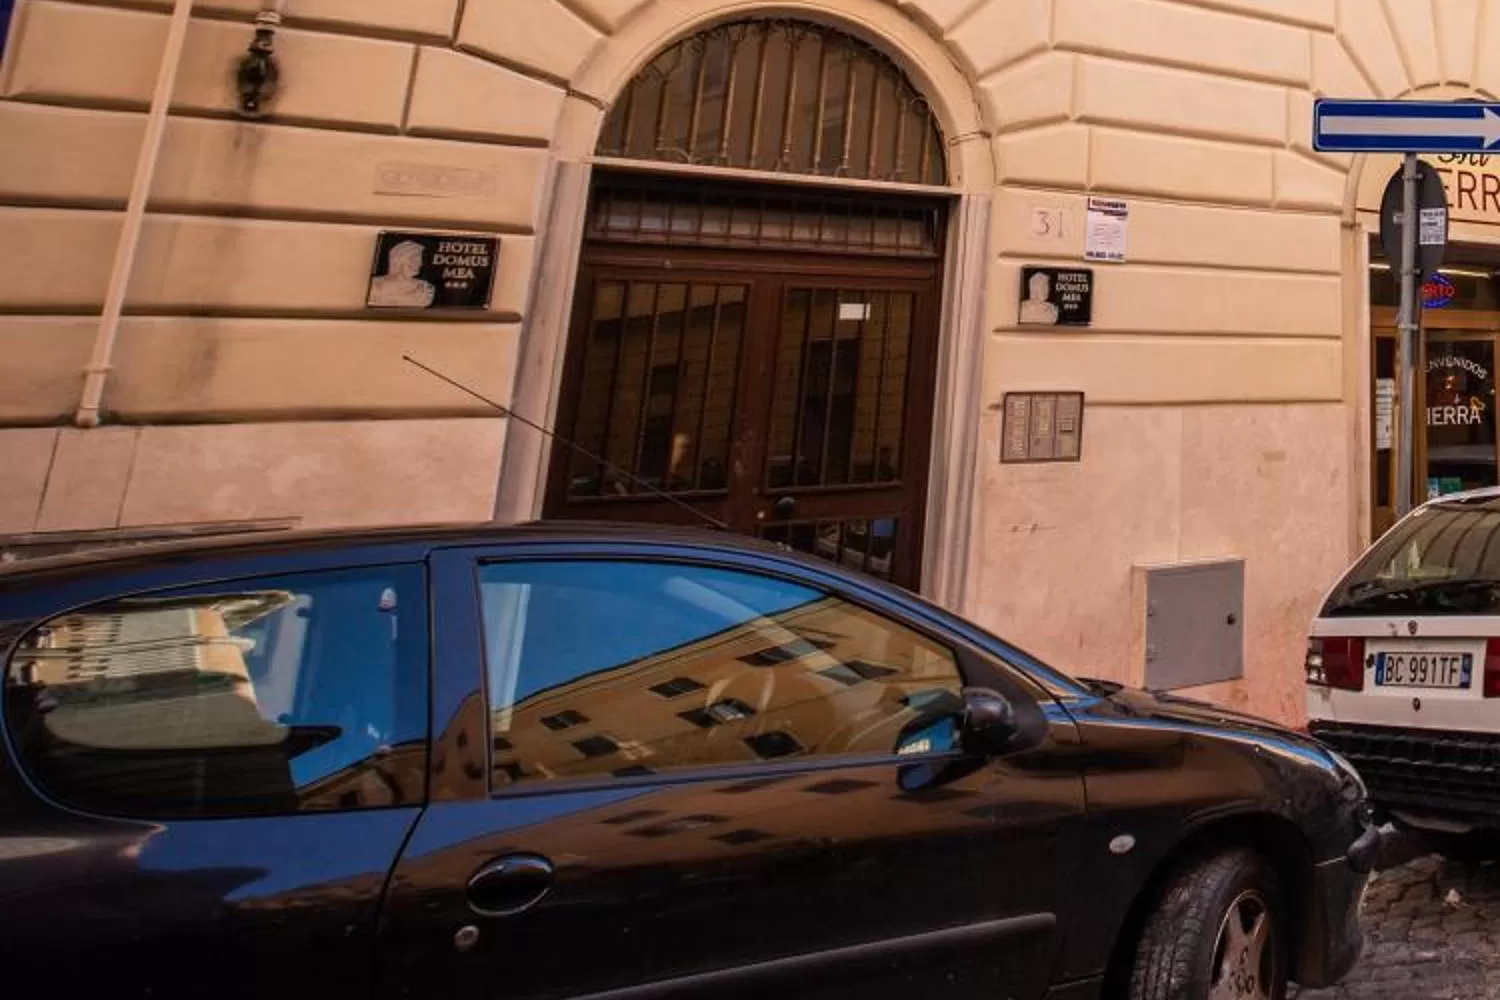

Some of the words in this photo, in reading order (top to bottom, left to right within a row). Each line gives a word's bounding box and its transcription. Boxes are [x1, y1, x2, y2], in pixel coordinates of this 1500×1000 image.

[438, 241, 488, 255] HOTEL
[431, 253, 490, 267] DOMUS
[442, 267, 476, 279] MEA
[1057, 272, 1089, 282] HOTEL
[1385, 655, 1404, 683] BC
[1409, 656, 1460, 685] 991TF
